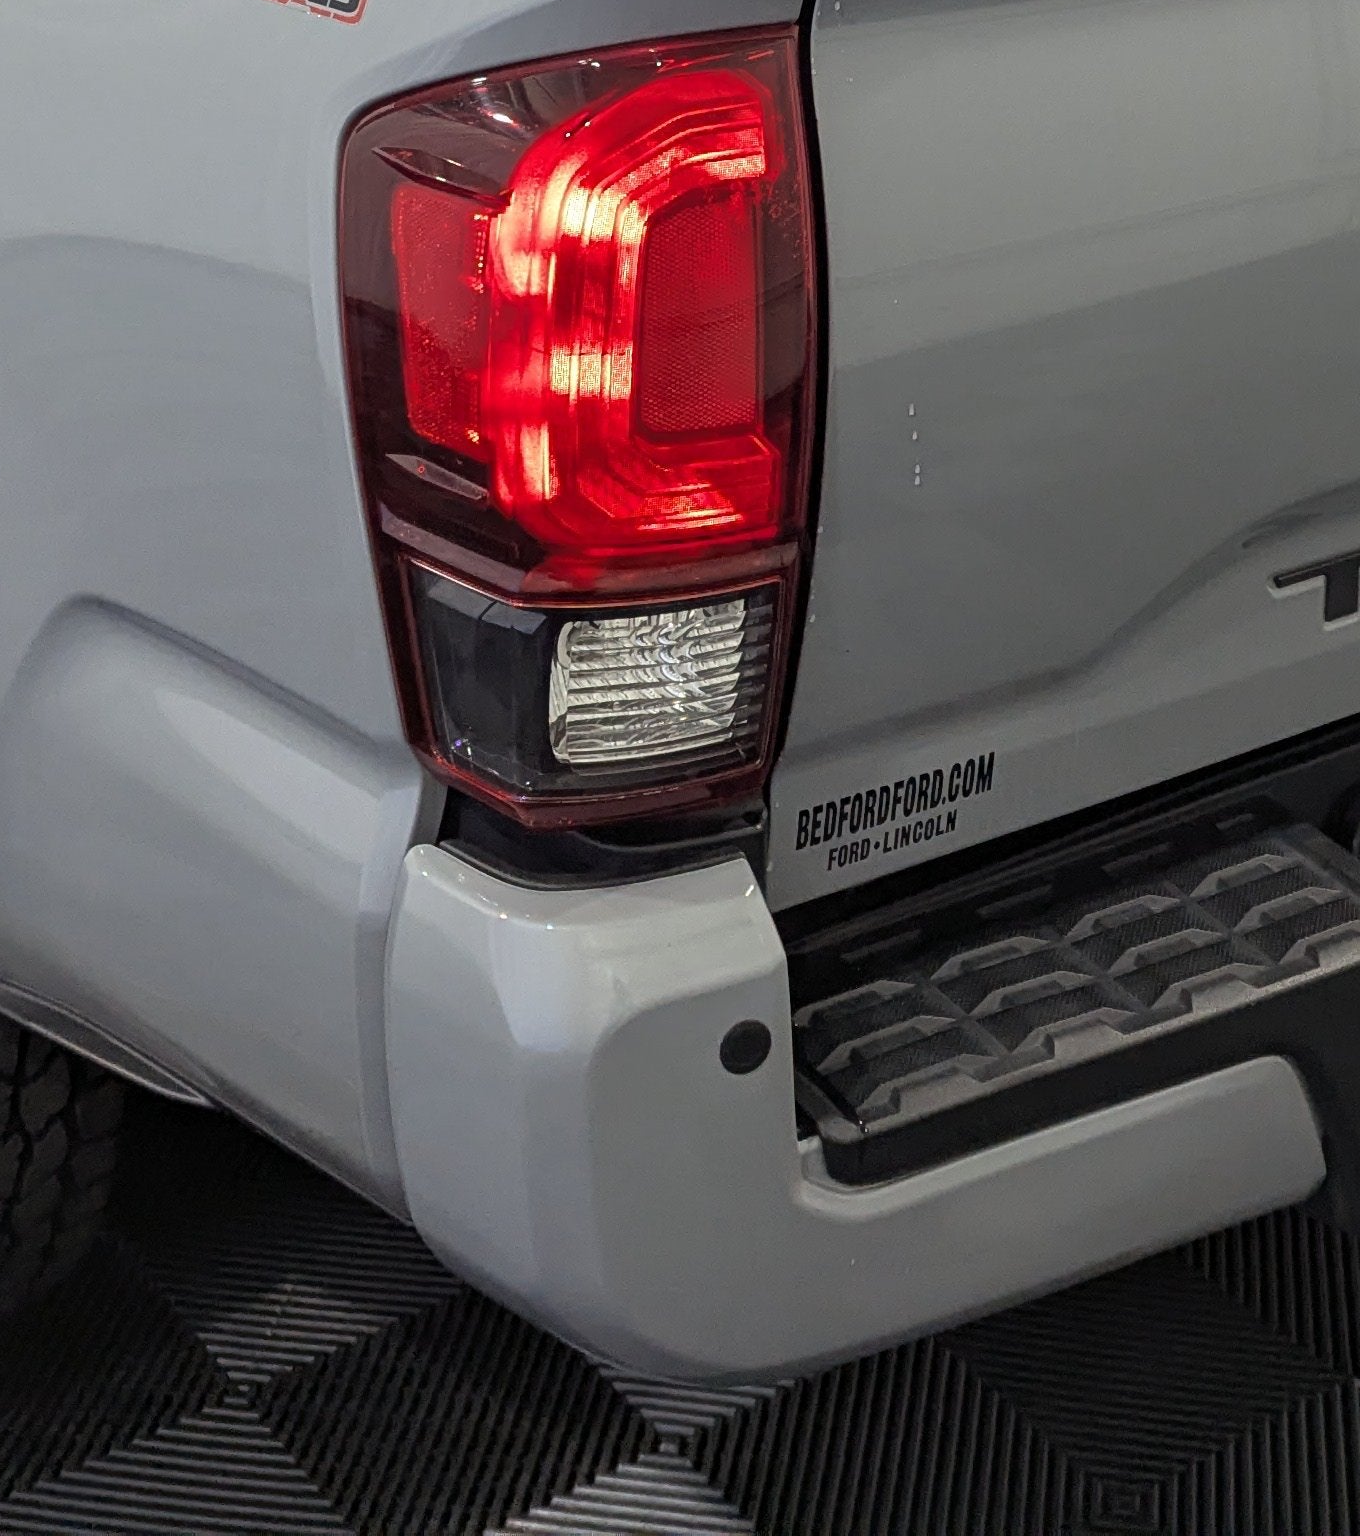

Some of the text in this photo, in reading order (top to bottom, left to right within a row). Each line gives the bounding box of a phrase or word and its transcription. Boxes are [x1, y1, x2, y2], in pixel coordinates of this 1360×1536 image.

[795, 752, 995, 850] BEDFORDFORD.COM
[827, 809, 958, 871] FORD LINCOLN
